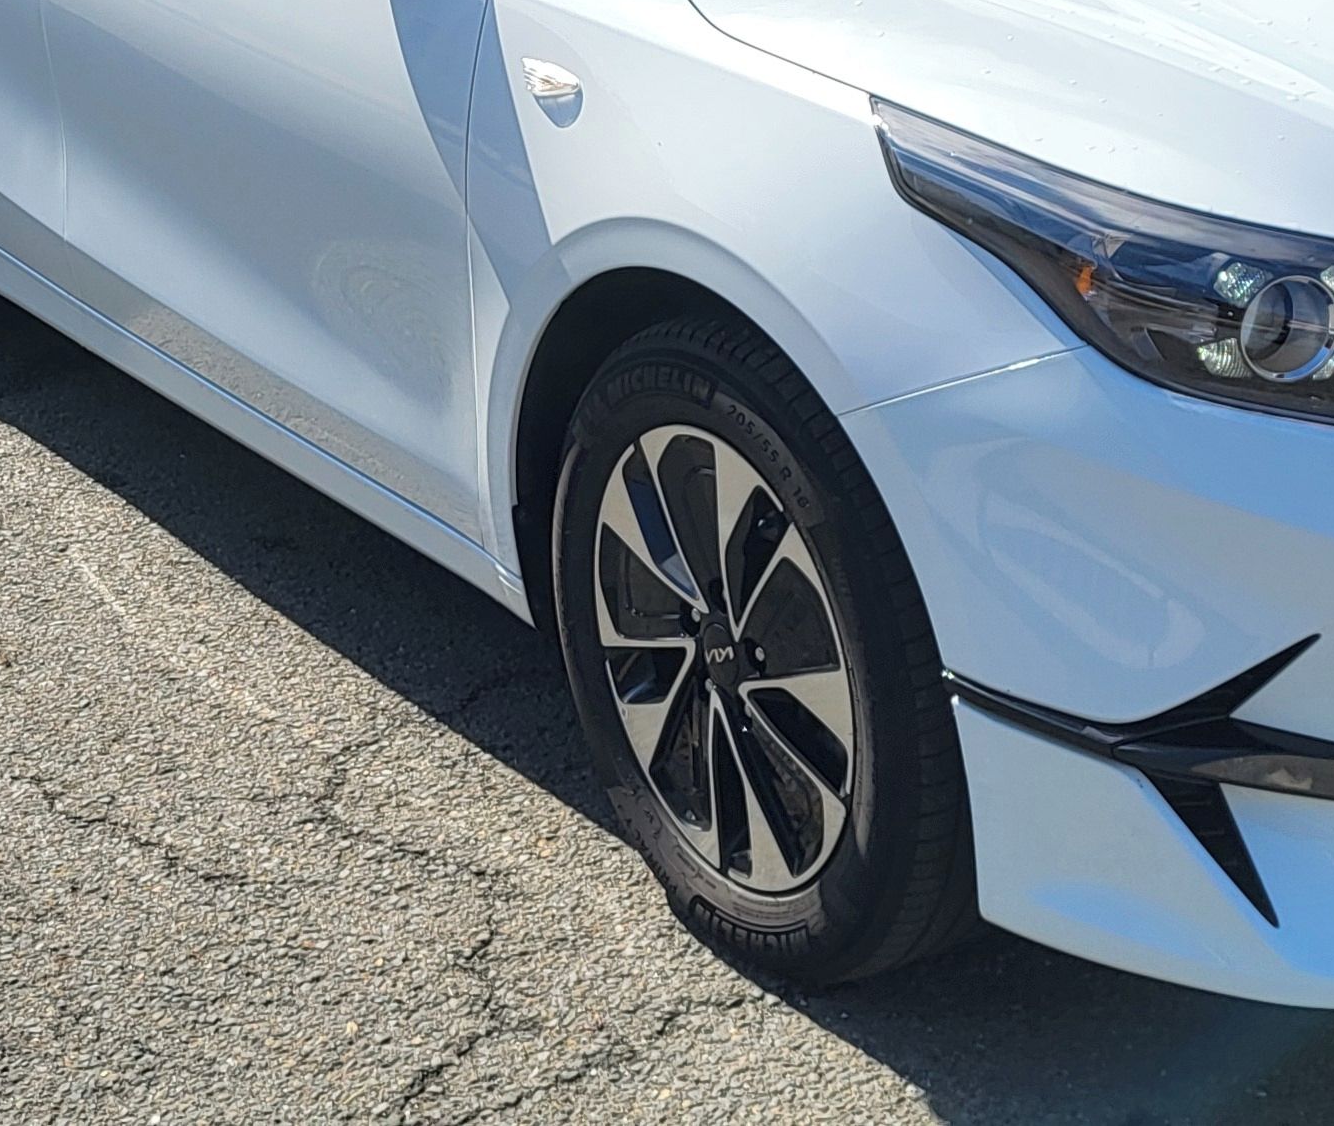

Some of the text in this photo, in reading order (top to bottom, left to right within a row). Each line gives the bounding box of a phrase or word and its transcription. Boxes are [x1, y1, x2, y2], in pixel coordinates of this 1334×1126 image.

[725, 404, 810, 509] 205/55 R 16
